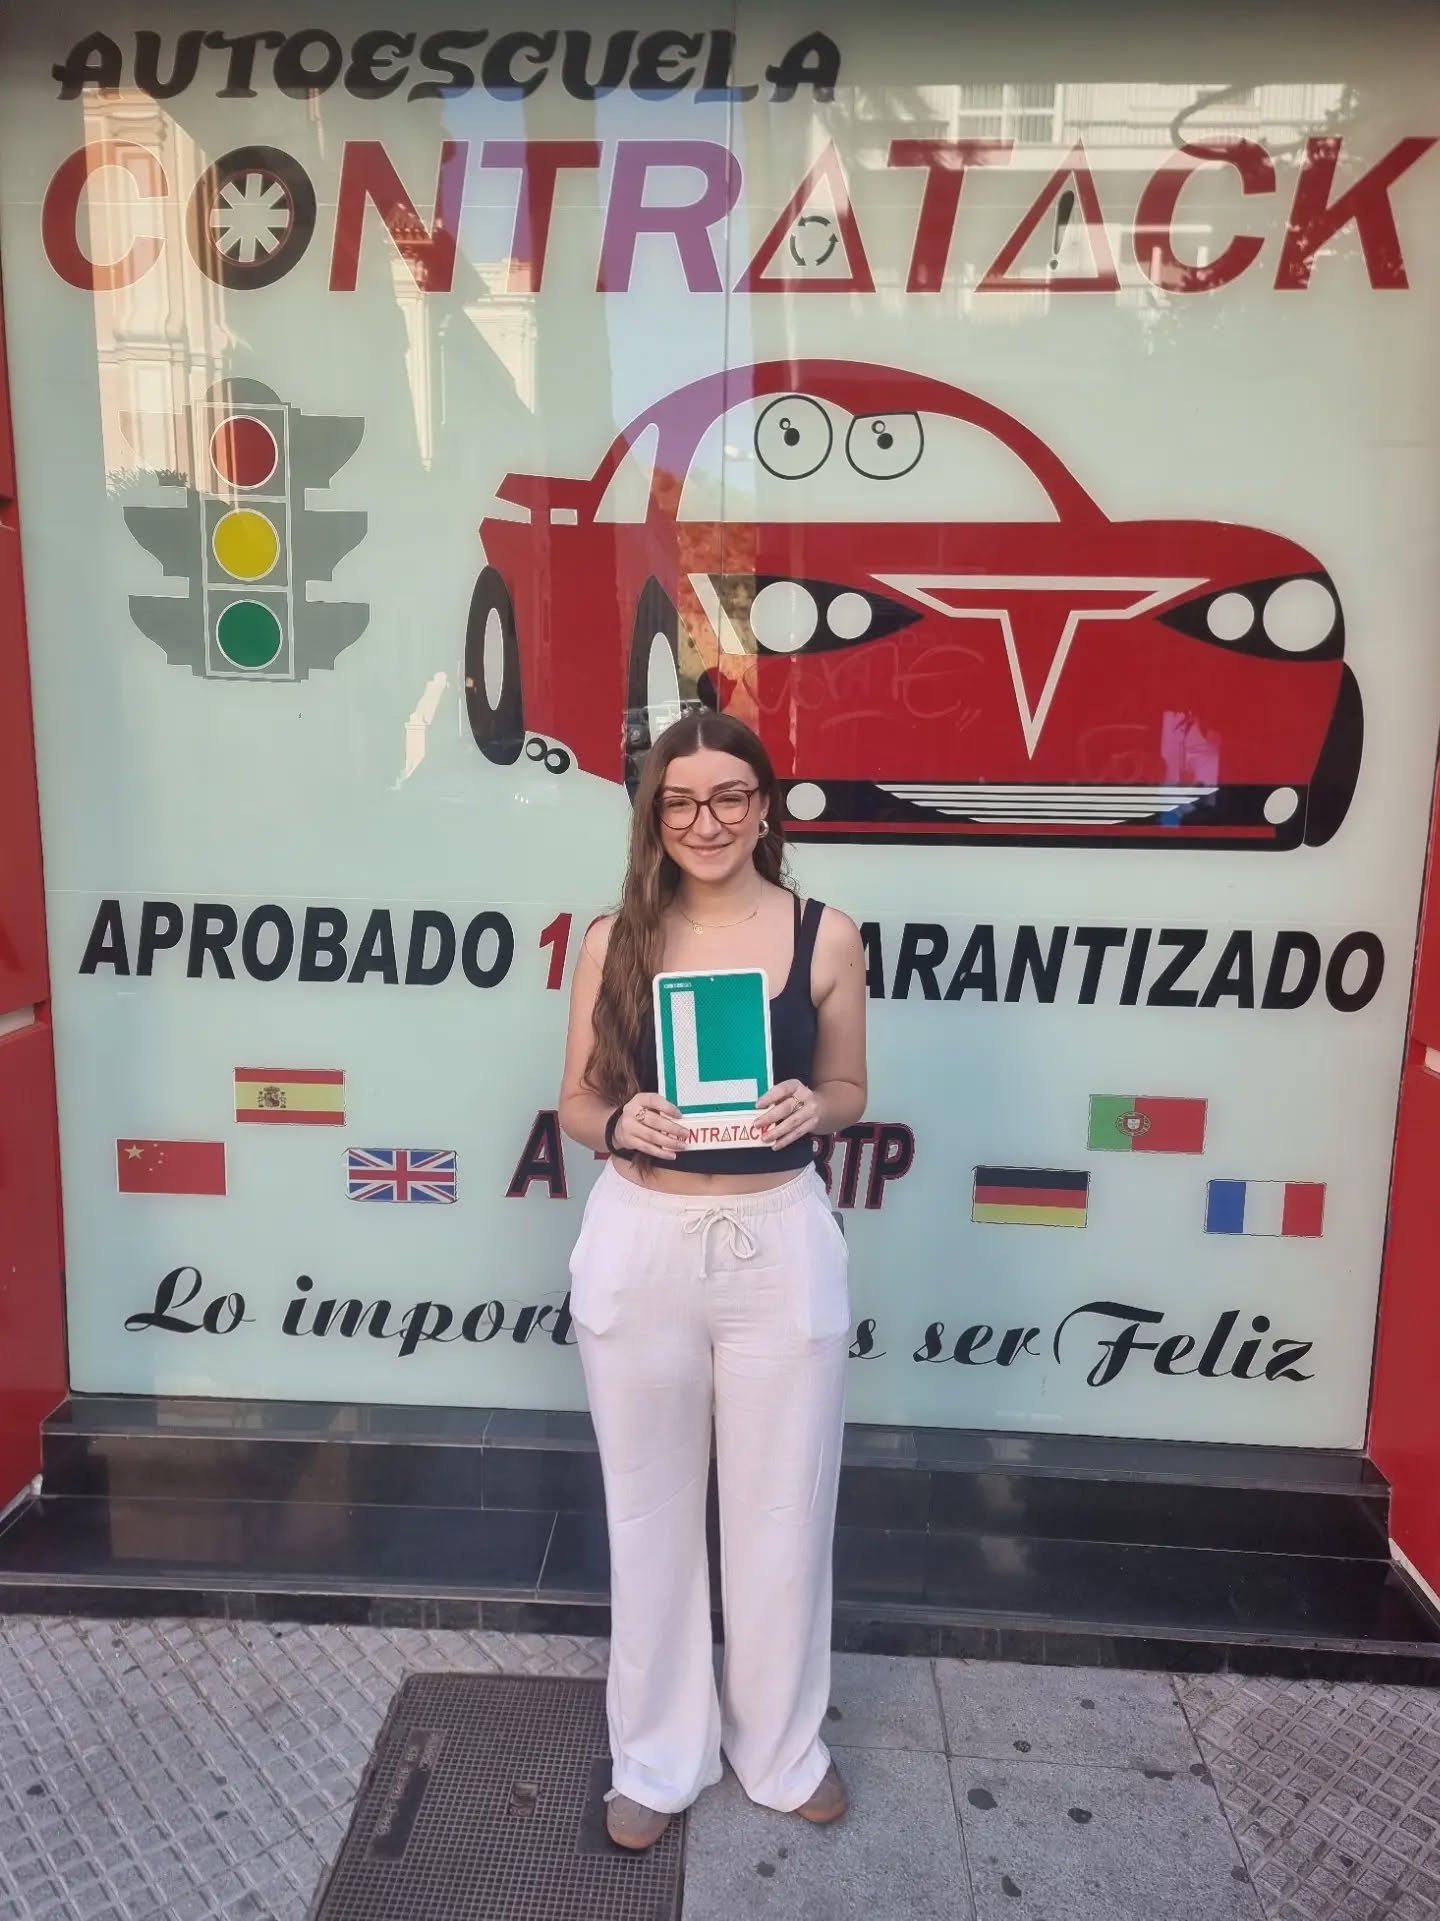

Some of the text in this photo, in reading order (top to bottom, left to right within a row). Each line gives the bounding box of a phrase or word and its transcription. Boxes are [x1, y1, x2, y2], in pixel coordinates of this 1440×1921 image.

[52, 28, 842, 103] AUTOESCUELA
[42, 136, 1440, 293] CONTRATACK
[79, 899, 515, 989] APROBADO
[860, 922, 1385, 1013] ARANTIZADO
[670, 990, 758, 1106] L
[504, 1110, 568, 1199] A
[124, 1266, 1315, 1387] Lo import s ser Feliz
